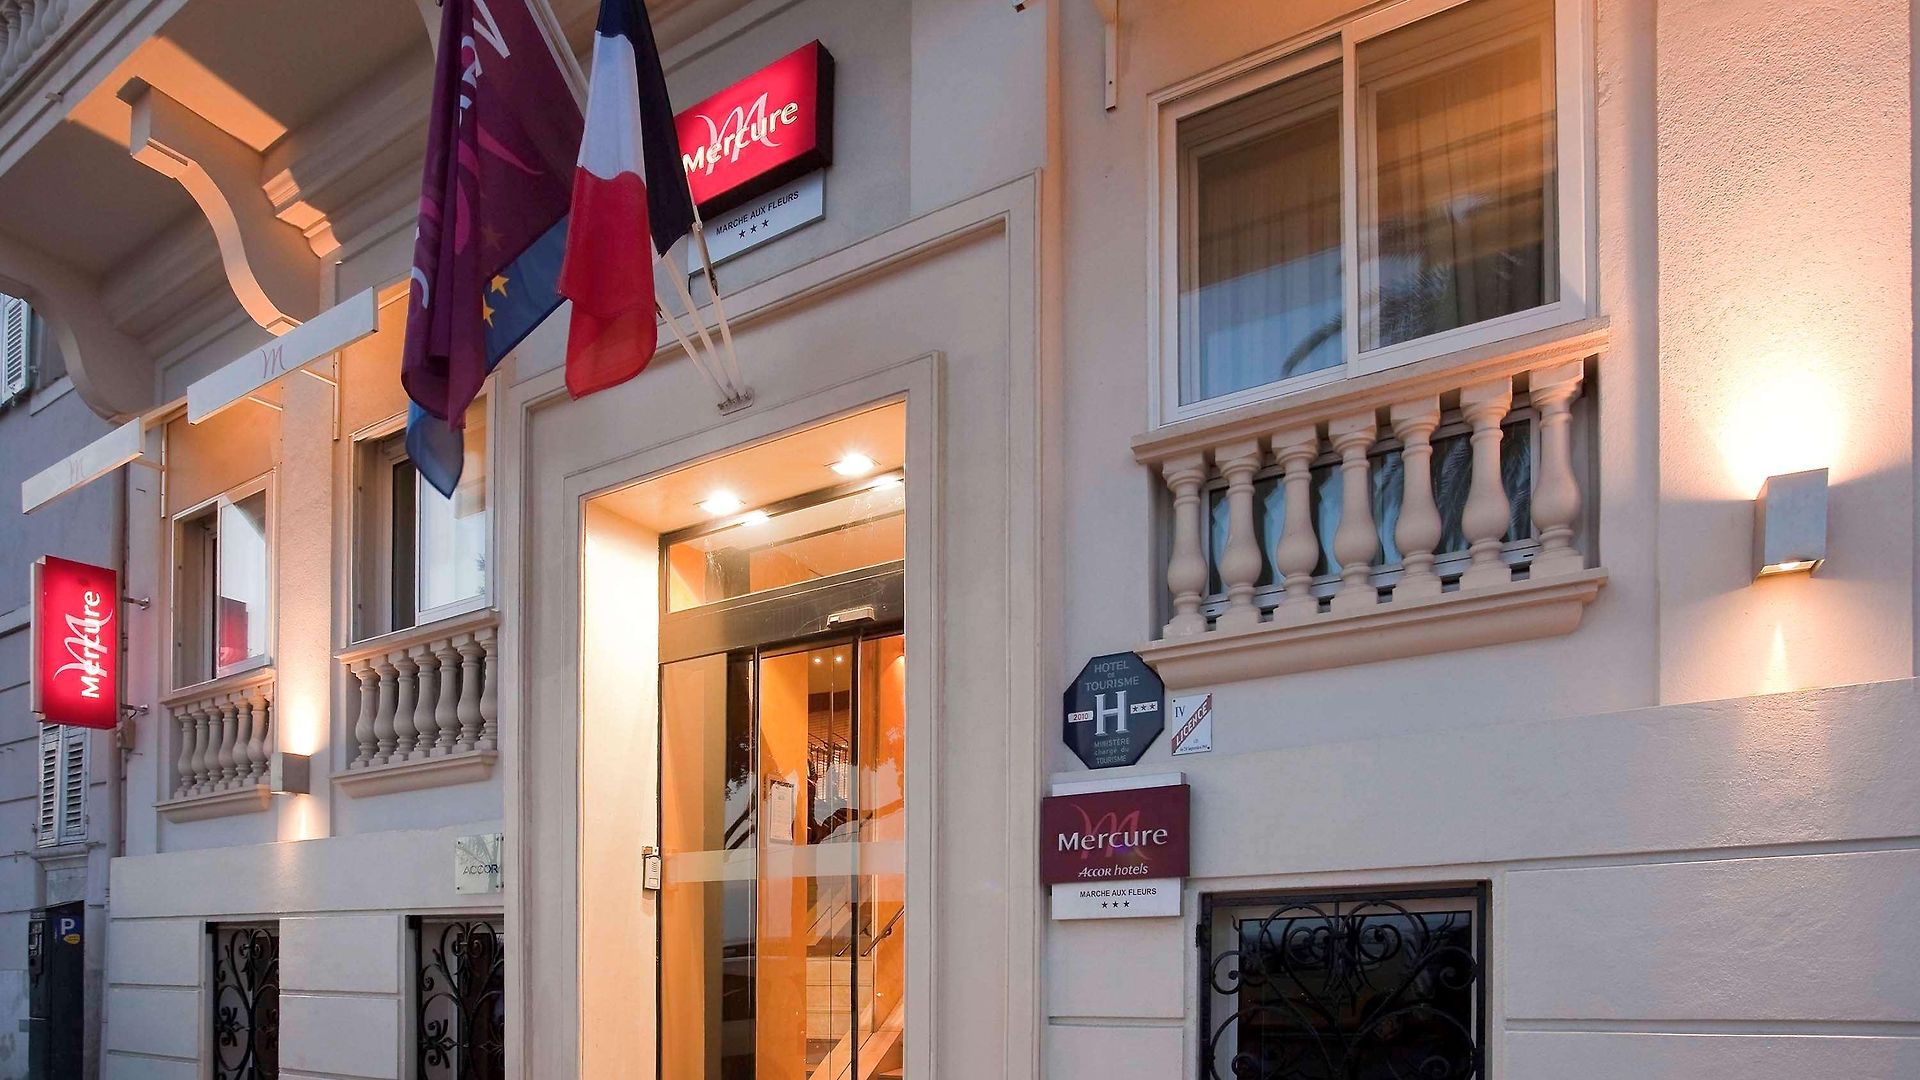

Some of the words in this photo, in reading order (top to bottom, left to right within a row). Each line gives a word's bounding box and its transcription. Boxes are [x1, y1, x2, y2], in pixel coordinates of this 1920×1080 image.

[682, 102, 798, 174] Mercure
[716, 215, 748, 236] MARCHE
[750, 205, 766, 219] AUX
[768, 191, 799, 211] FLEURS
[81, 591, 100, 698] Mercure
[1094, 660, 1129, 673] HOTEL
[1085, 675, 1140, 691] TOURISME
[1073, 713, 1089, 721] 2010
[1094, 690, 1129, 736] H
[1175, 705, 1185, 718] IV
[1176, 701, 1208, 746] LICENCE
[1058, 828, 1168, 852] Mercure
[463, 864, 499, 875] ACCOR
[1113, 863, 1149, 876] hotels
[1080, 888, 1110, 898] MARCHE
[1111, 889, 1127, 897] AUX
[1128, 887, 1157, 896] FLEURS
[61, 918, 75, 935] P
